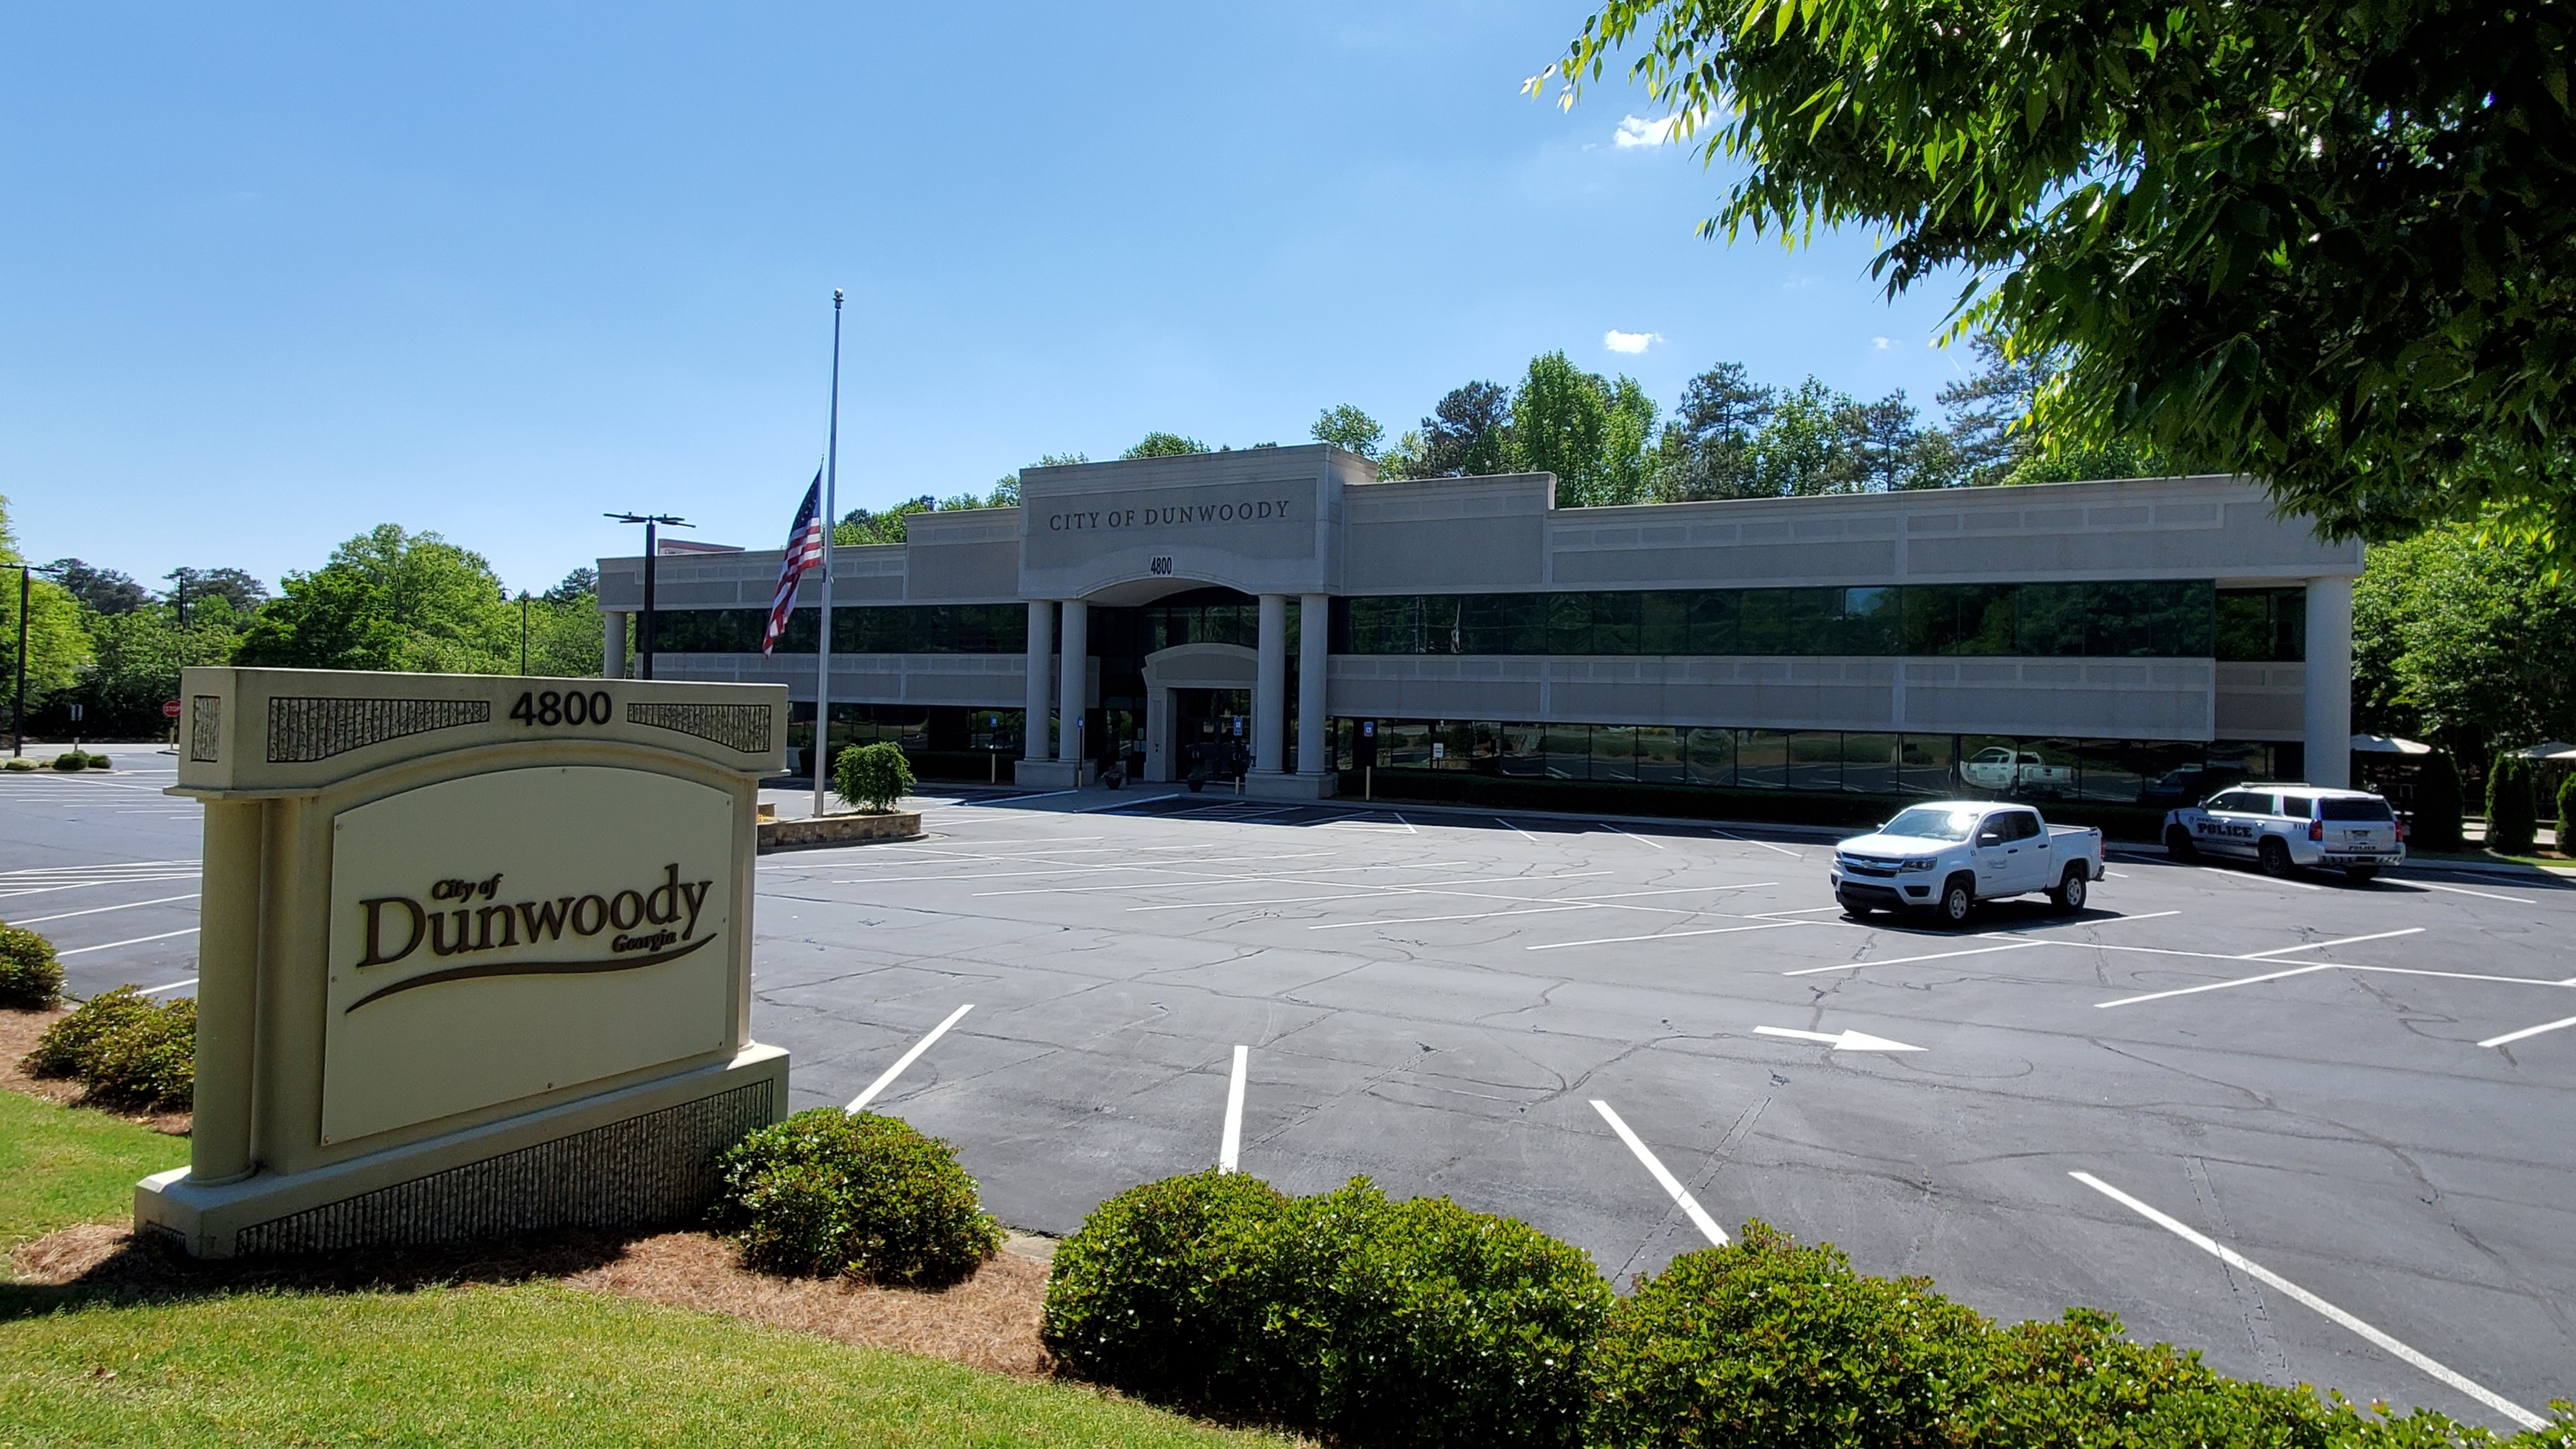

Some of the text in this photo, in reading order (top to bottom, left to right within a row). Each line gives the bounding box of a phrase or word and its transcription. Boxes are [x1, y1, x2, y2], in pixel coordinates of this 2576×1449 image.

[1050, 500, 1289, 531] CITY OF DUNWOODY
[1150, 557, 1172, 575] 4800
[509, 691, 612, 727] 4800
[2197, 822, 2253, 838] POLICE
[431, 873, 504, 903] City of
[357, 863, 714, 969] Dunwoody
[612, 928, 678, 953] Georgia
